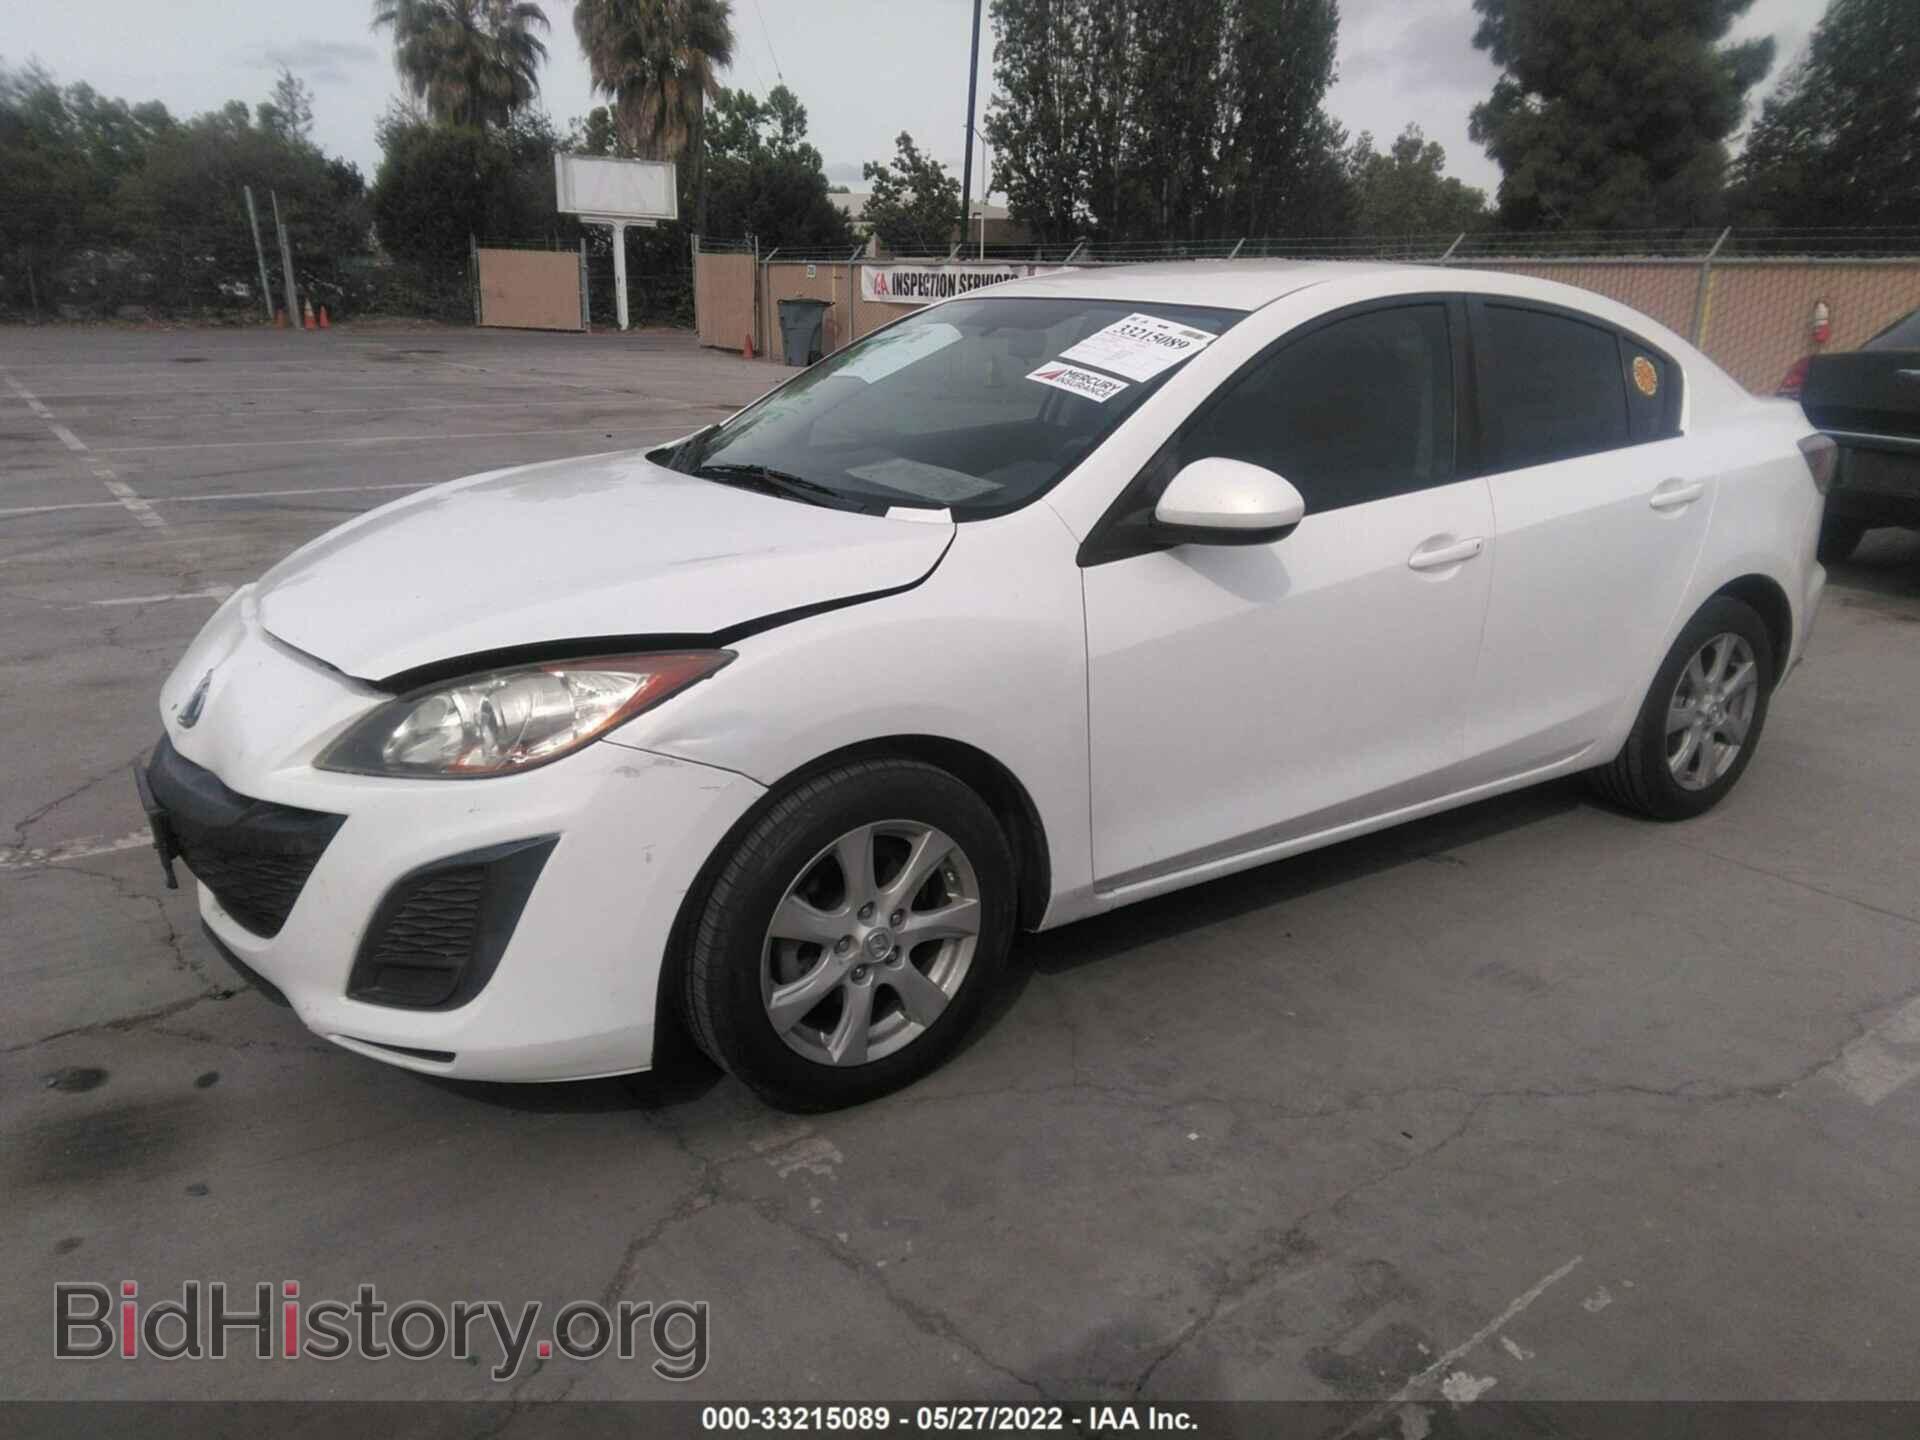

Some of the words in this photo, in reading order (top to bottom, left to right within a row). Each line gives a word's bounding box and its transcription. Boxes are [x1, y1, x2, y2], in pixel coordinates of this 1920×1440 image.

[892, 271, 957, 298] INSPECTION
[959, 273, 1019, 294] SERV
[1112, 324, 1191, 349] 33215089
[1057, 377, 1111, 398] INSURANCE
[1064, 369, 1121, 391] MERCURY
